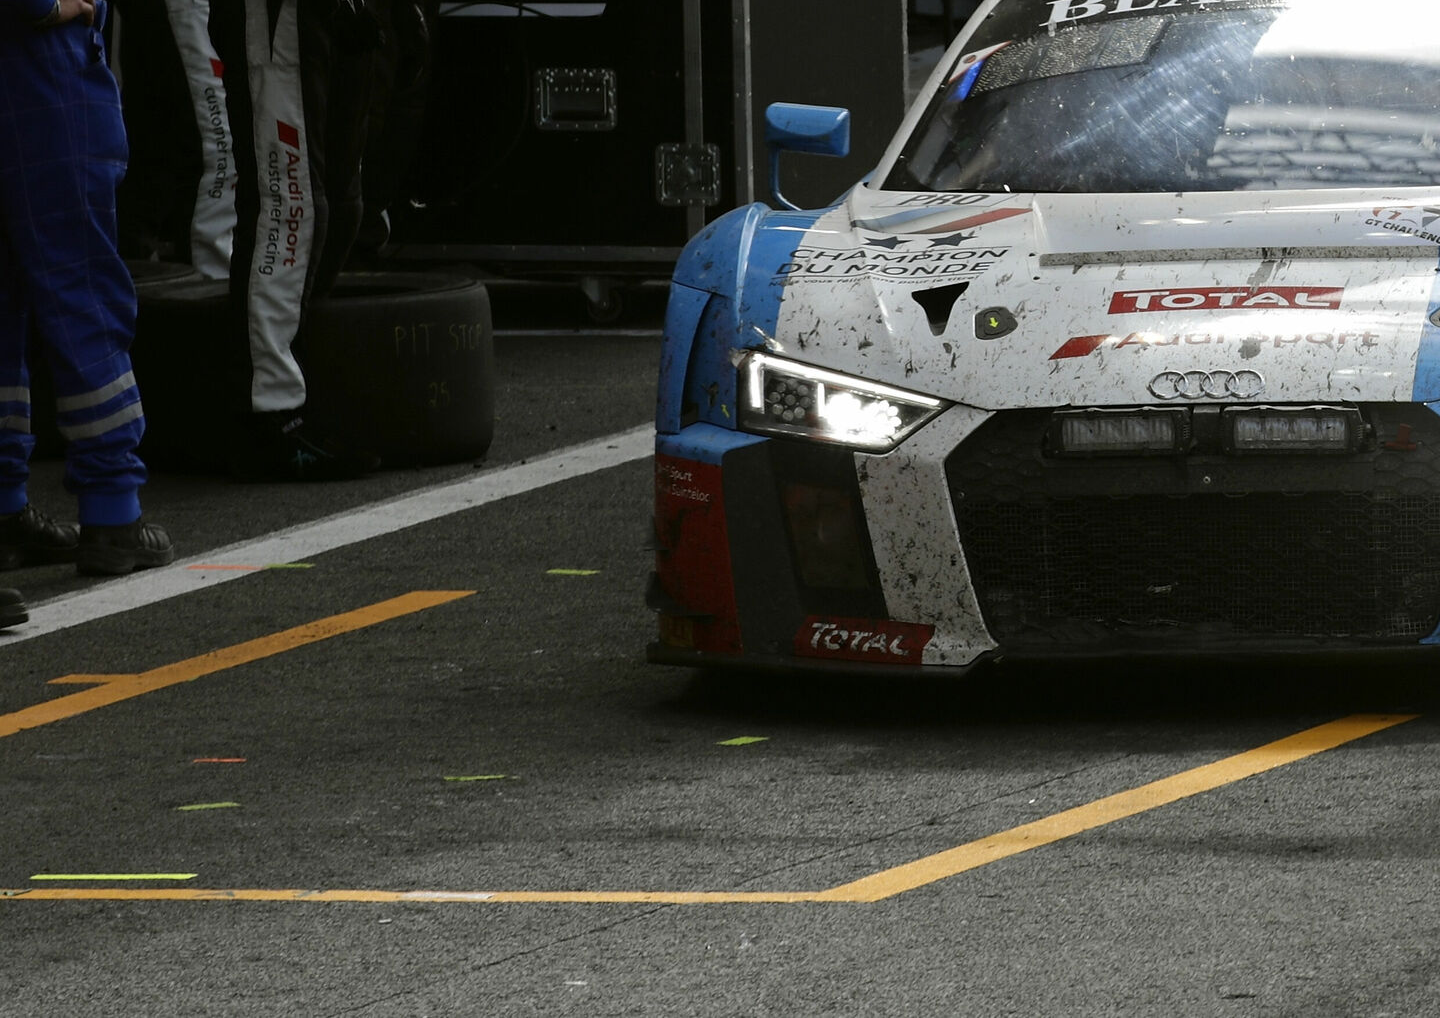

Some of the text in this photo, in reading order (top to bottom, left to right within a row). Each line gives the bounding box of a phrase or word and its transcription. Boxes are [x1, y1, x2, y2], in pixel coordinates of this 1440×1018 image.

[204, 87, 228, 199] customer racing
[258, 150, 283, 276] customer racing
[283, 150, 304, 267] Audi Sport
[898, 194, 991, 206] PRO
[1364, 218, 1382, 226] GT
[775, 261, 996, 276] DU MONDE
[789, 248, 1008, 263] CHAMPION
[1123, 290, 1331, 310] TOTAL
[394, 323, 435, 359] PIT
[807, 622, 910, 657] TOTAL
